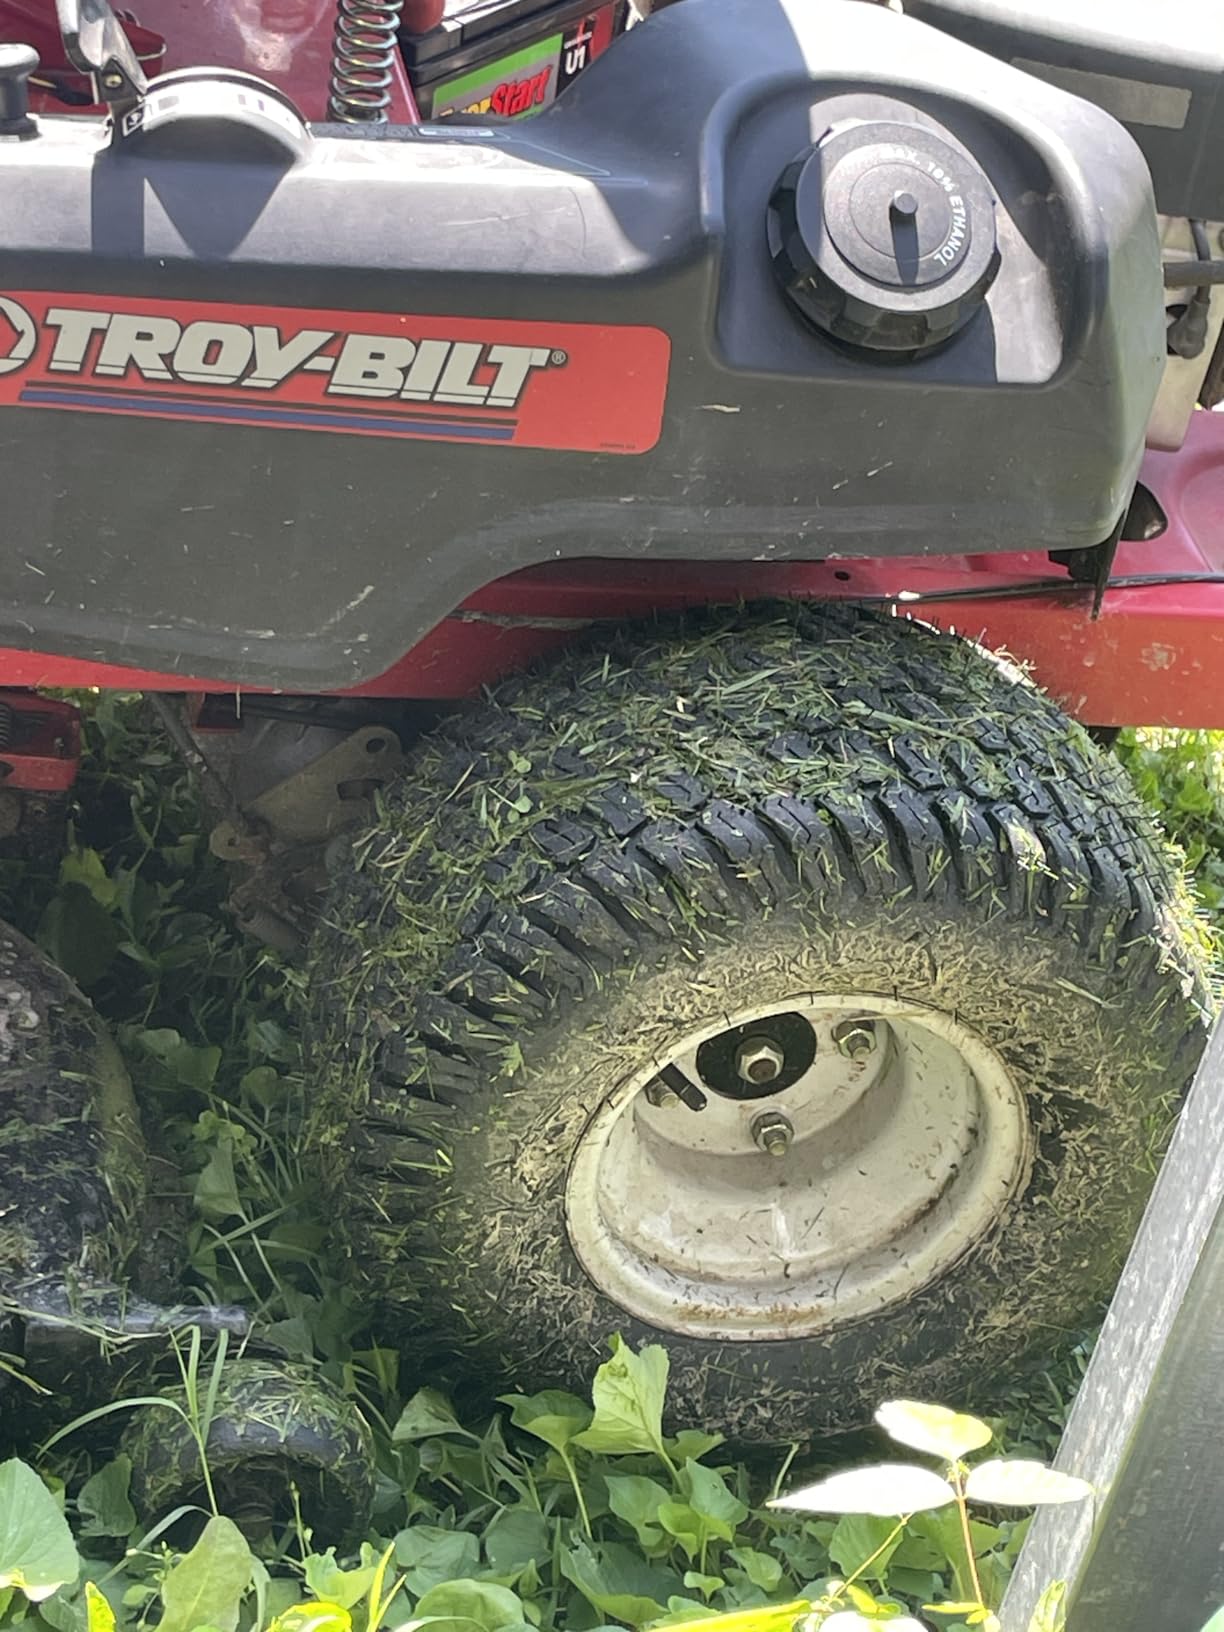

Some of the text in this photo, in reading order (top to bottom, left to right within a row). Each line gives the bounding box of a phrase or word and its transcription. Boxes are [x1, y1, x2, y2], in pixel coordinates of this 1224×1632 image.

[926, 161, 956, 193] 10%
[933, 194, 967, 266] ETHANOL
[44, 306, 551, 408] TROY-BILT
